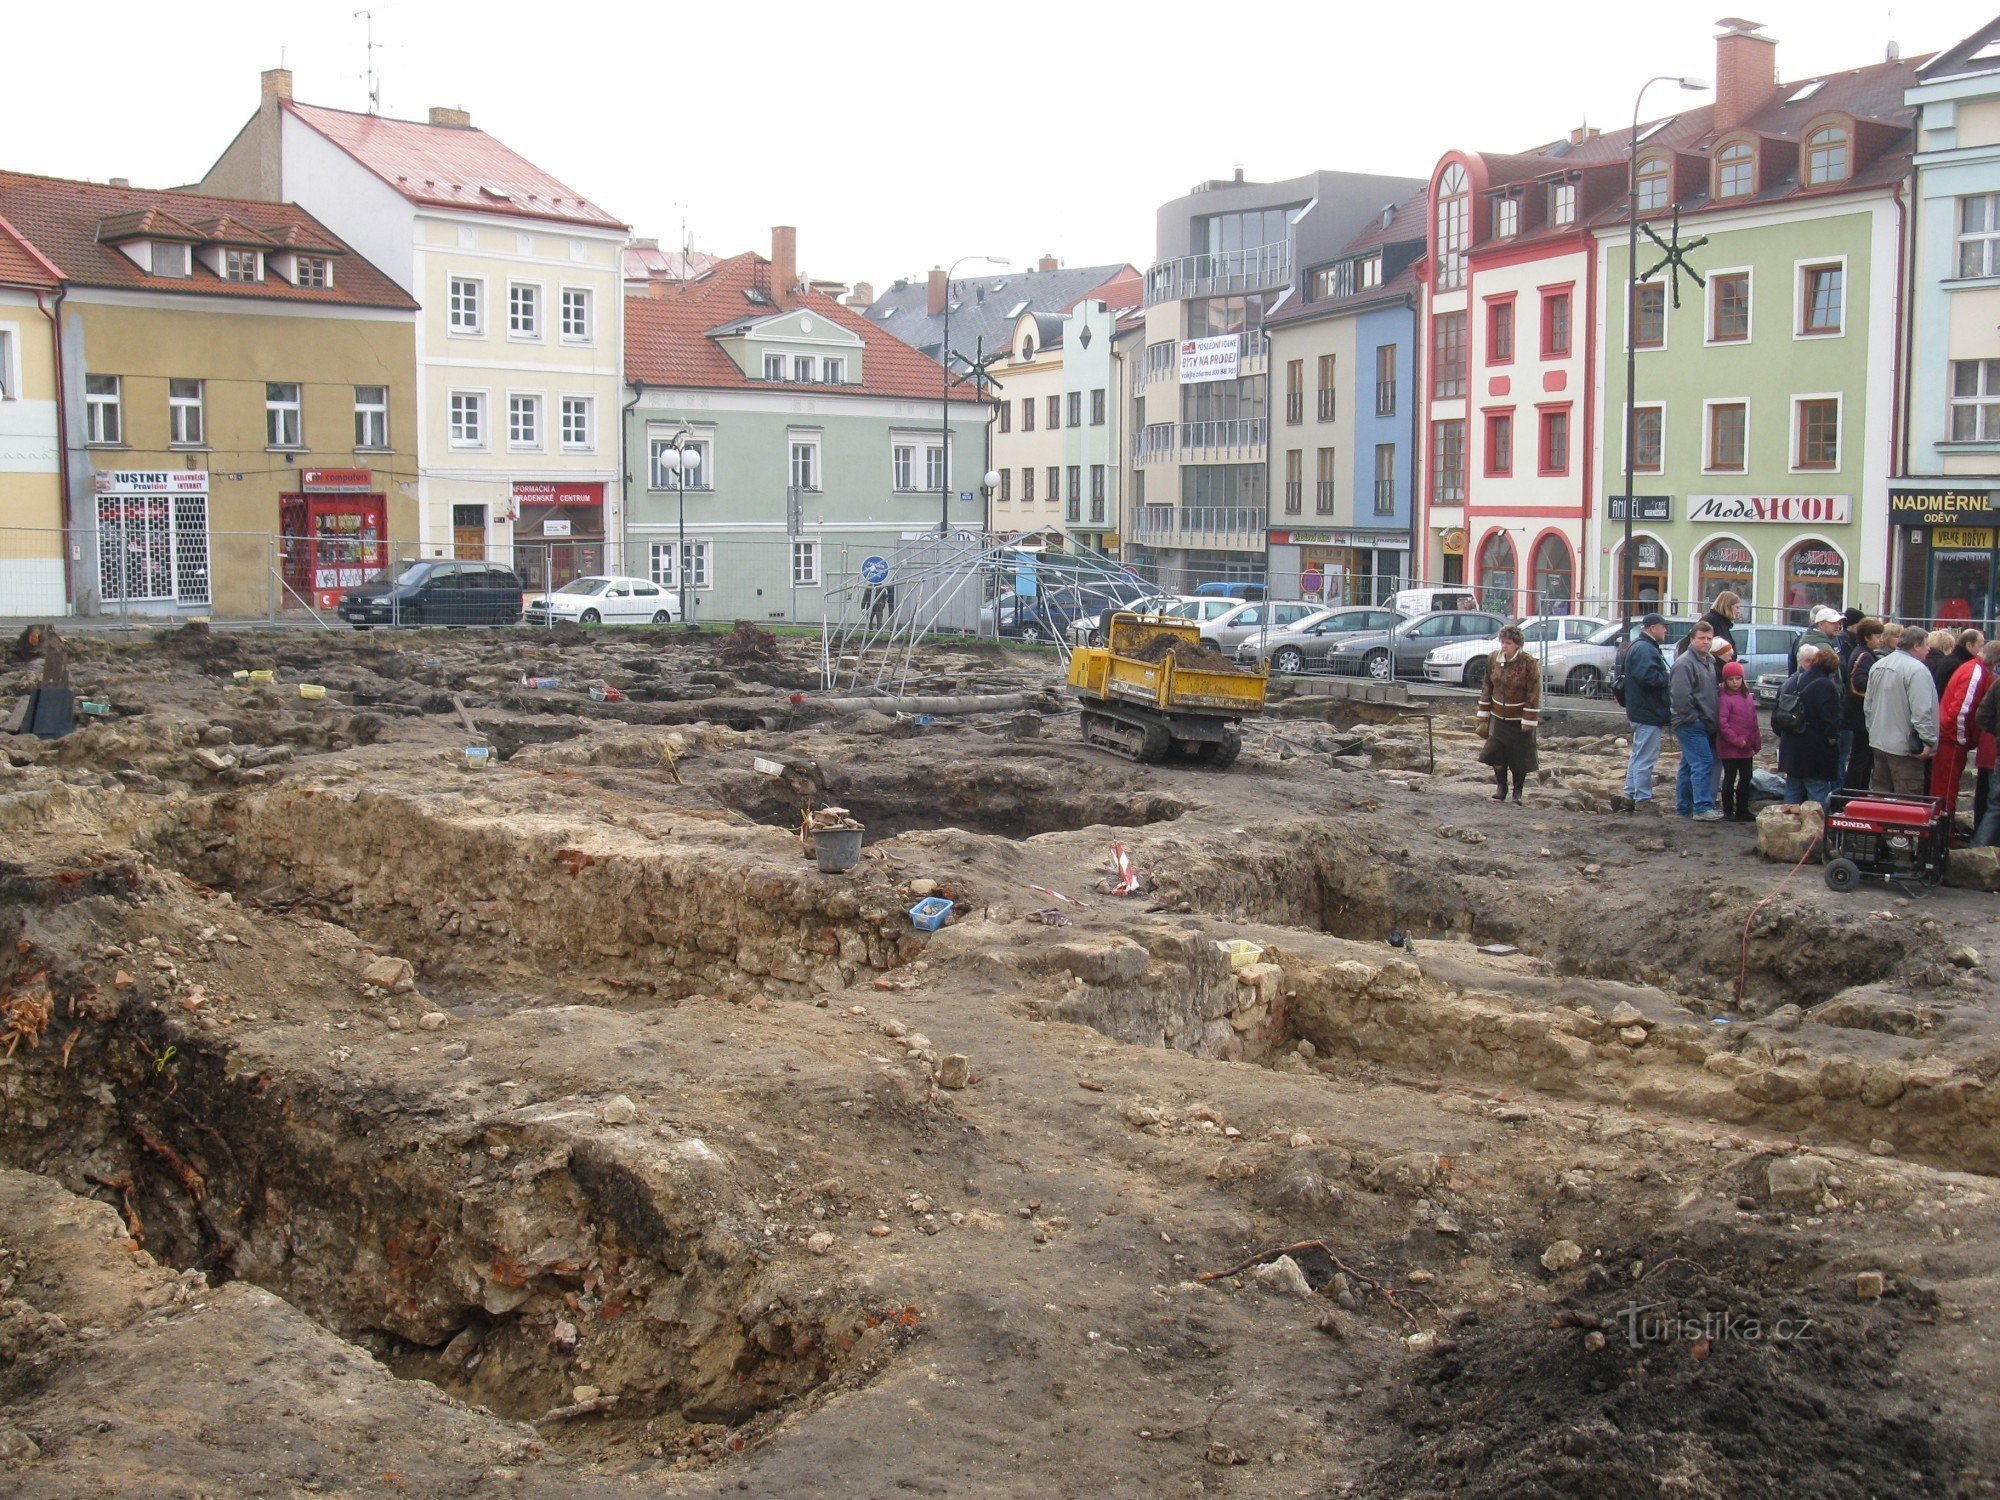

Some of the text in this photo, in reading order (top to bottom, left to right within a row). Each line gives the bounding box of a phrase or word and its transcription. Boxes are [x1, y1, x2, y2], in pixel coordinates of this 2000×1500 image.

[1200, 355, 1209, 366] NA
[1210, 352, 1237, 365] PRODEJ
[1612, 498, 1640, 518] ANĚL
[1690, 498, 1844, 520] Mode NICOL
[1924, 512, 1958, 522] ODĚVY
[1962, 529, 1987, 546] ODĚVY
[1832, 820, 1872, 830] HONDA
